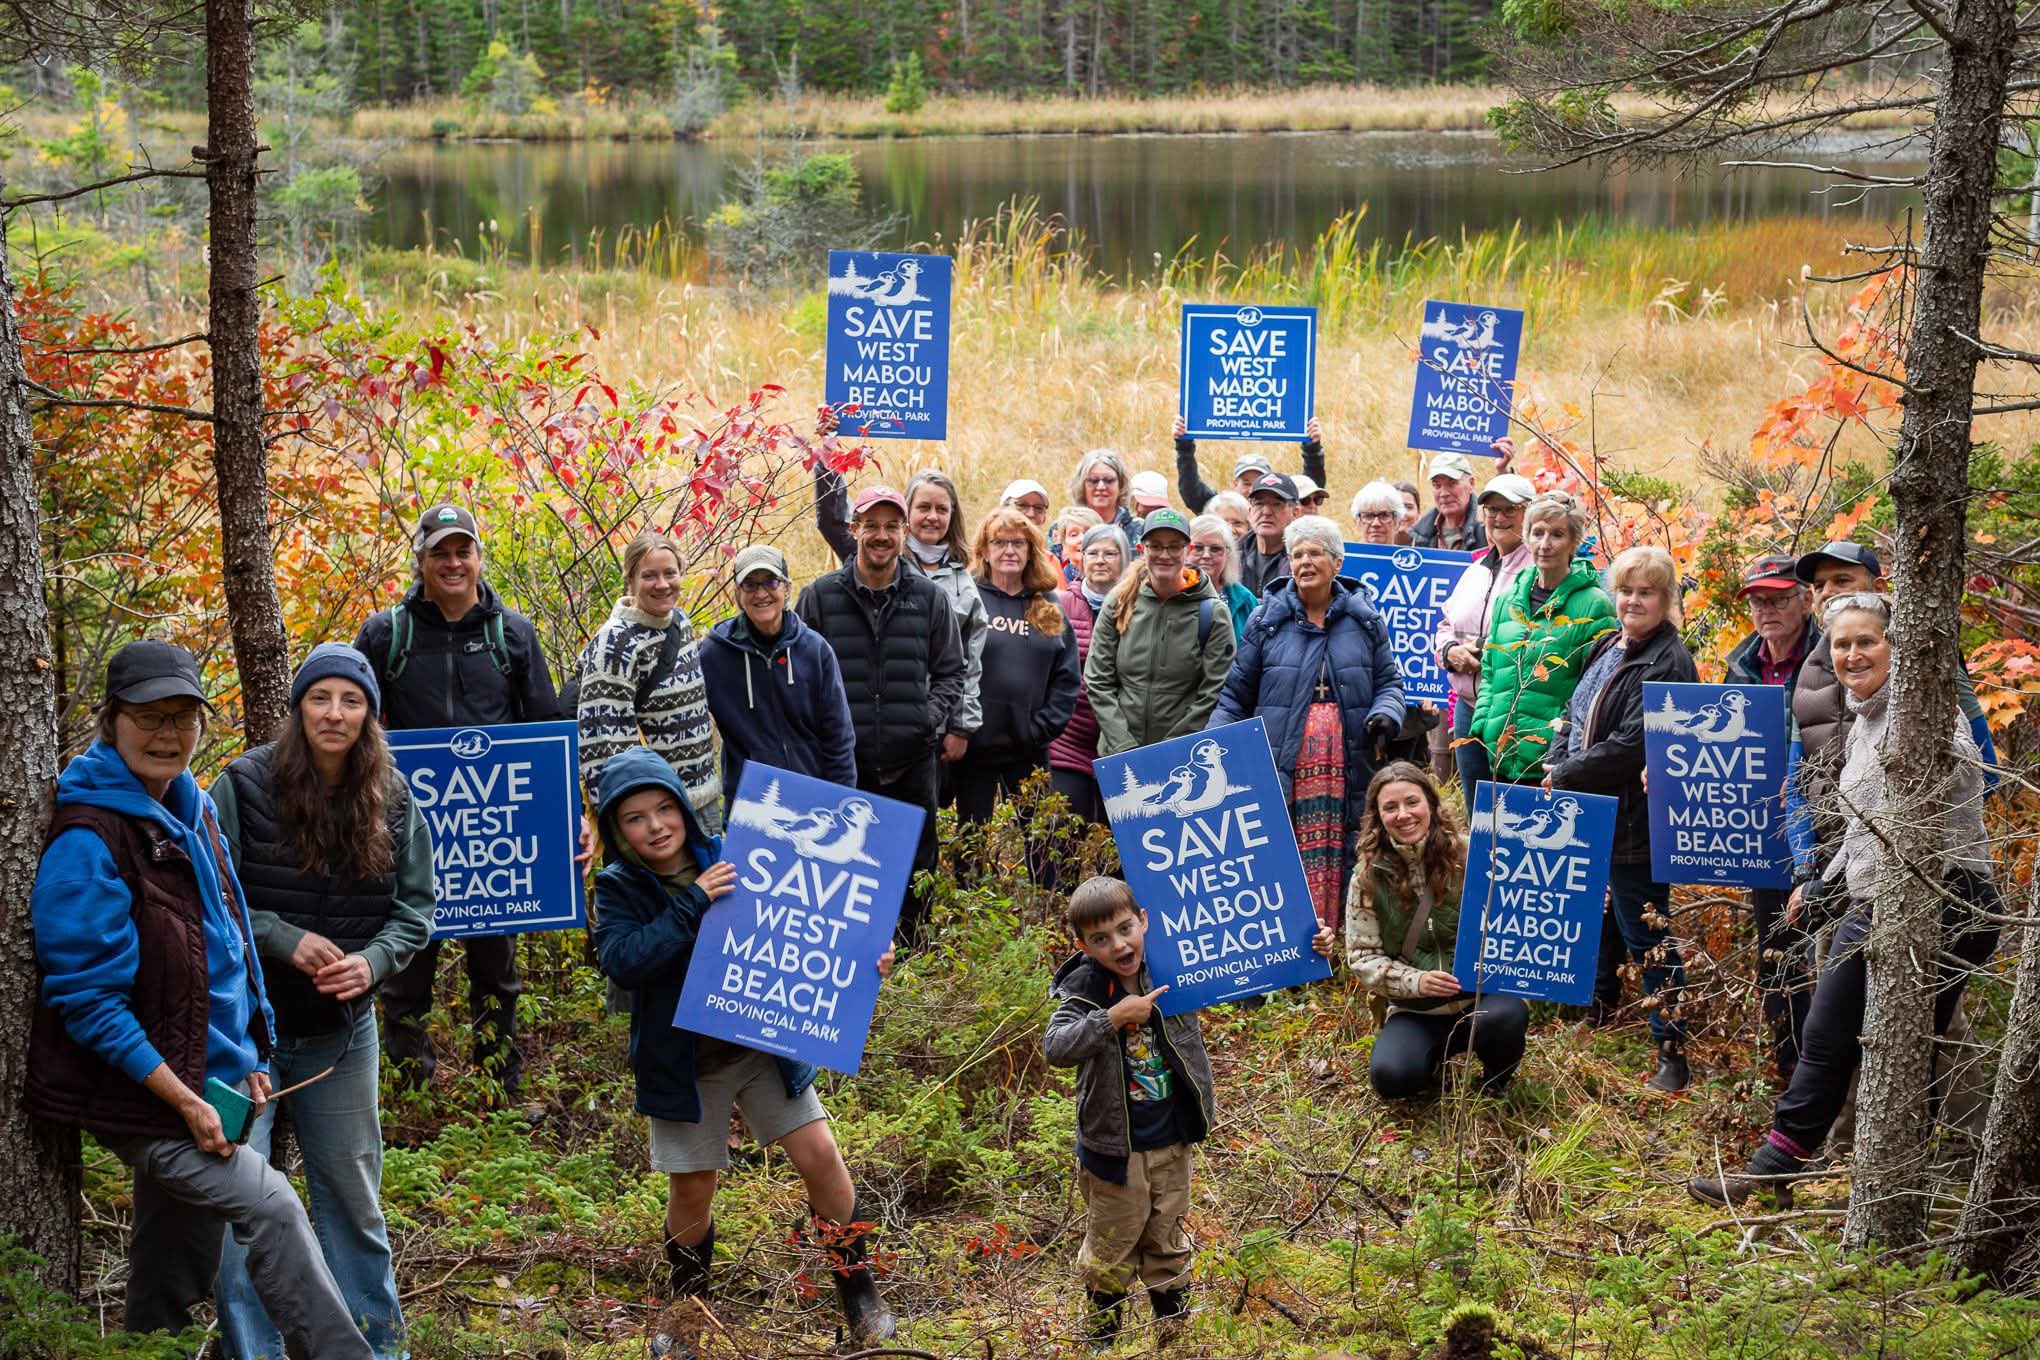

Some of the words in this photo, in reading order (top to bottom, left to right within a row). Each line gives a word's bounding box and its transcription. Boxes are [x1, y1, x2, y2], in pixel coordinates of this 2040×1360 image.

[844, 307, 933, 340] SAVE
[857, 341, 919, 362] WEST
[1210, 329, 1287, 356] SAVE
[844, 364, 931, 385] MABOU
[1221, 357, 1276, 376] WEST
[1433, 347, 1504, 377] SAVE
[1209, 378, 1287, 397] MABOU
[1440, 375, 1490, 393] WEST
[849, 387, 924, 408] BEACH
[1213, 398, 1281, 417] BEACH
[1427, 393, 1497, 414] MABOU
[905, 412, 930, 421] PARK
[1206, 419, 1260, 428] PROVINCIAL
[1263, 421, 1285, 429] PARK
[1429, 411, 1490, 432] BEACH
[1422, 429, 1470, 440] PROVINCIAL
[1472, 435, 1493, 443] PARK
[1360, 572, 1450, 607] SAVE
[987, 616, 1029, 636] OVE
[1394, 656, 1438, 679] ACH
[1416, 683, 1443, 693] PARK
[1666, 744, 1767, 780] SAVE
[411, 762, 532, 807] SAVE
[1682, 782, 1752, 804] WEST
[431, 805, 519, 839] WEST
[1669, 806, 1768, 830] MABOU
[1142, 803, 1269, 871] SAVE
[1677, 831, 1763, 855] BEACH
[1486, 847, 1590, 891] SAVE
[1670, 855, 1739, 867] PROVINCIAL
[1742, 859, 1771, 869] PARK
[740, 848, 879, 924] SAVE
[1169, 855, 1254, 899] WEST
[434, 904, 501, 919] OVINCIAL
[506, 900, 541, 913] PARK
[1161, 882, 1284, 936] MABOU
[1499, 886, 1570, 915] WEST
[755, 899, 847, 949] WEST
[1480, 909, 1581, 943] MABOU
[1177, 917, 1285, 967] BEACH
[1483, 938, 1570, 968] BEACH
[722, 927, 857, 989] MABOU
[1177, 956, 1262, 987] PROVINCIAL
[1265, 947, 1300, 967] PARK
[1474, 962, 1542, 980] PROVINCIAL
[1546, 971, 1575, 984] PARK
[722, 963, 838, 1020] BEACH
[706, 994, 796, 1032] PROVINCIAL
[801, 1019, 841, 1043] PARK
